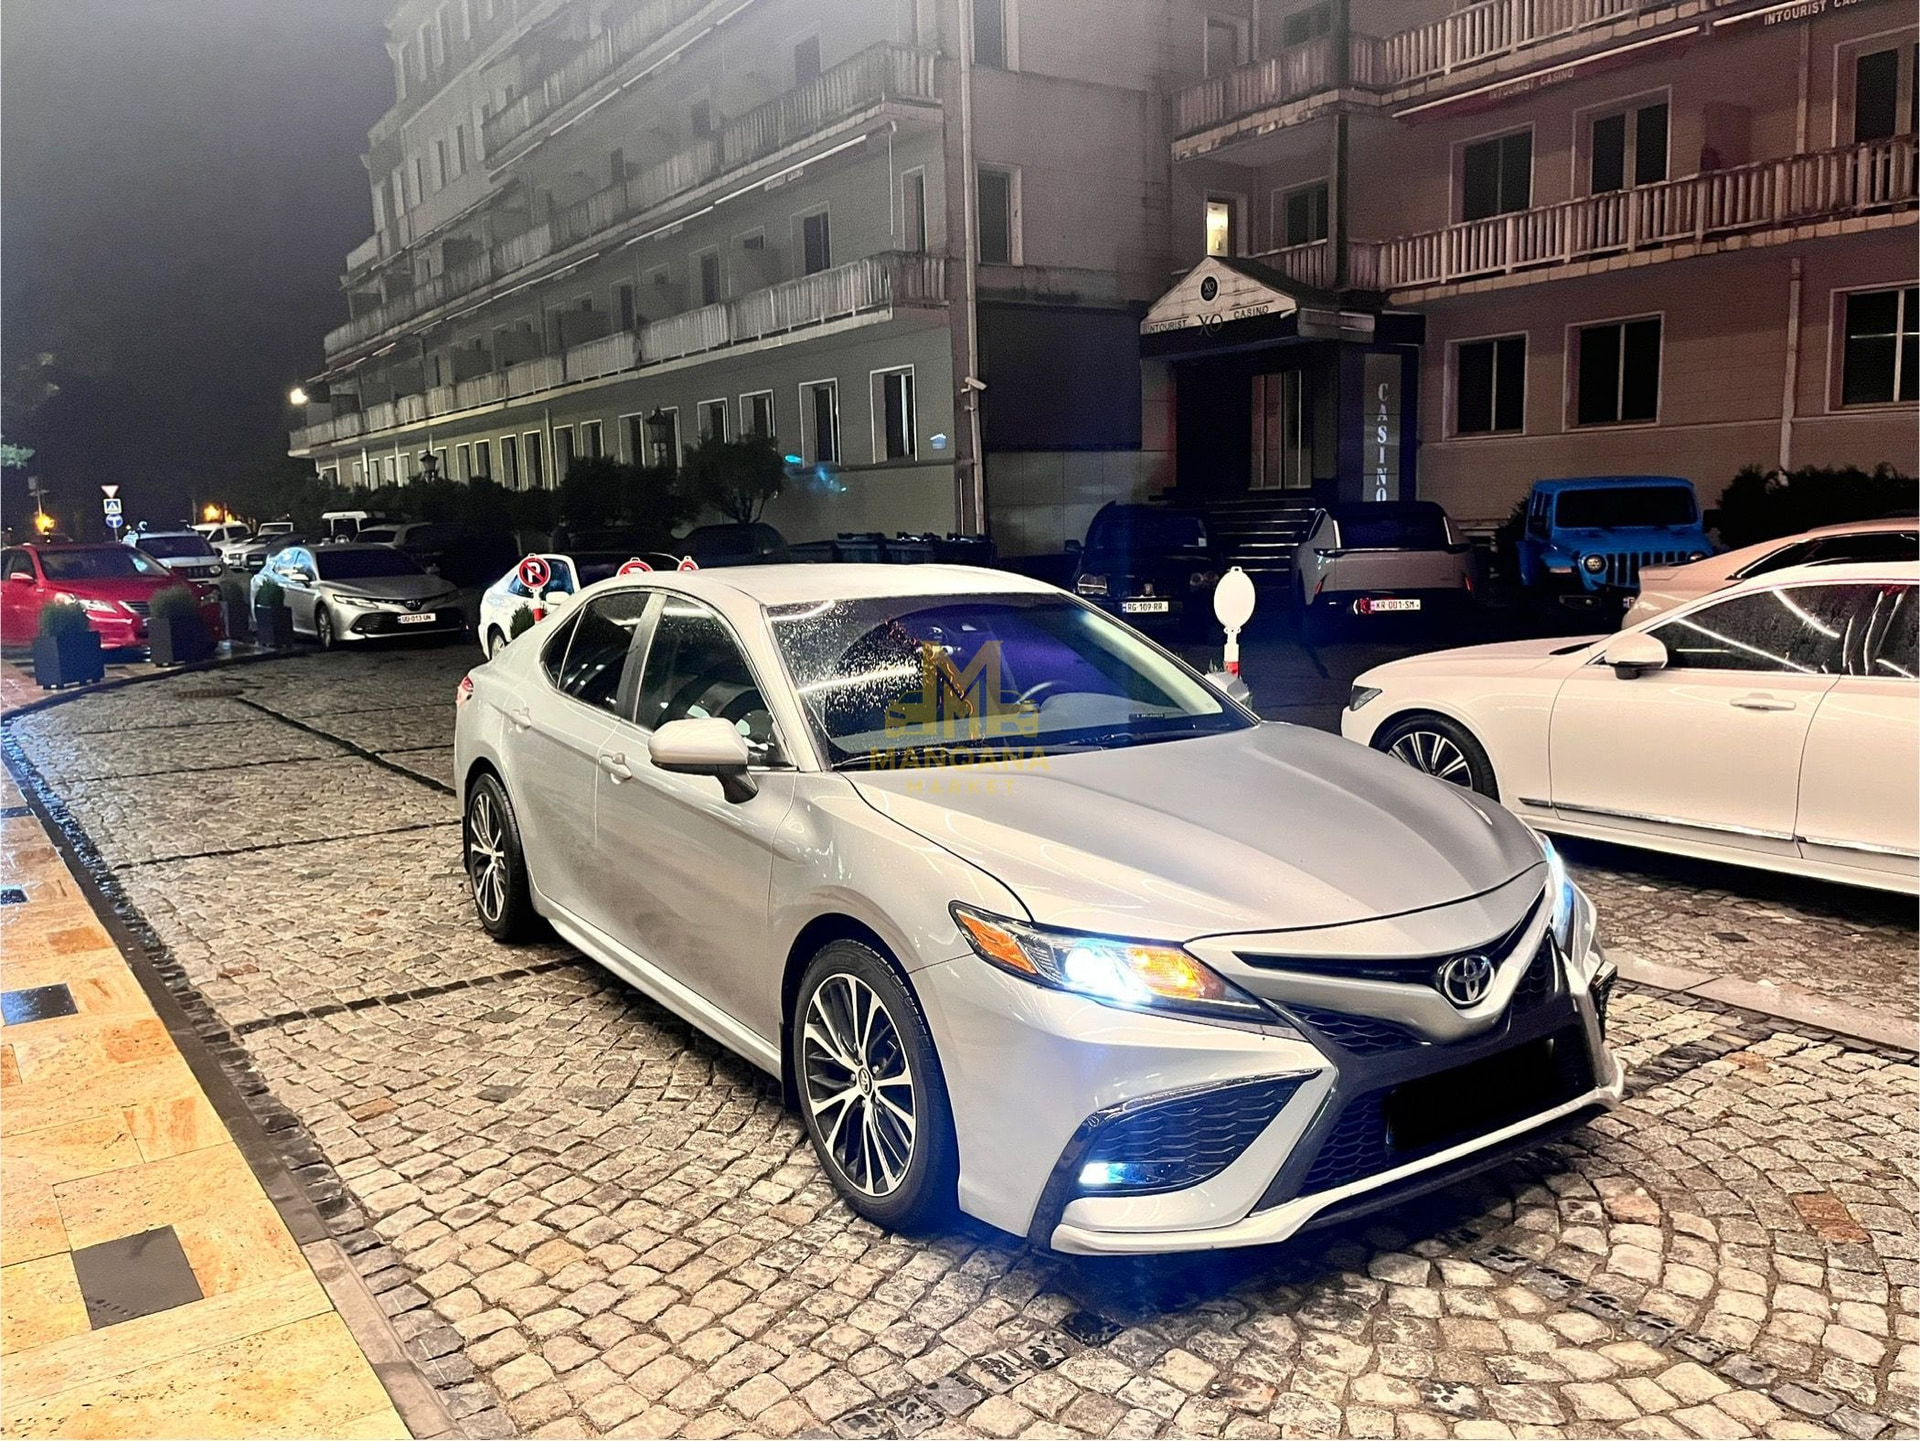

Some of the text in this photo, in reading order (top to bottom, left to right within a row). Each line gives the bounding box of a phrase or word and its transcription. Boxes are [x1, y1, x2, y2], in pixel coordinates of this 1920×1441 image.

[1764, 0, 1827, 26] INTOURIST
[1540, 68, 1574, 86] CASINO
[1233, 305, 1269, 319] CASINO
[1376, 383, 1389, 502] CASINO
